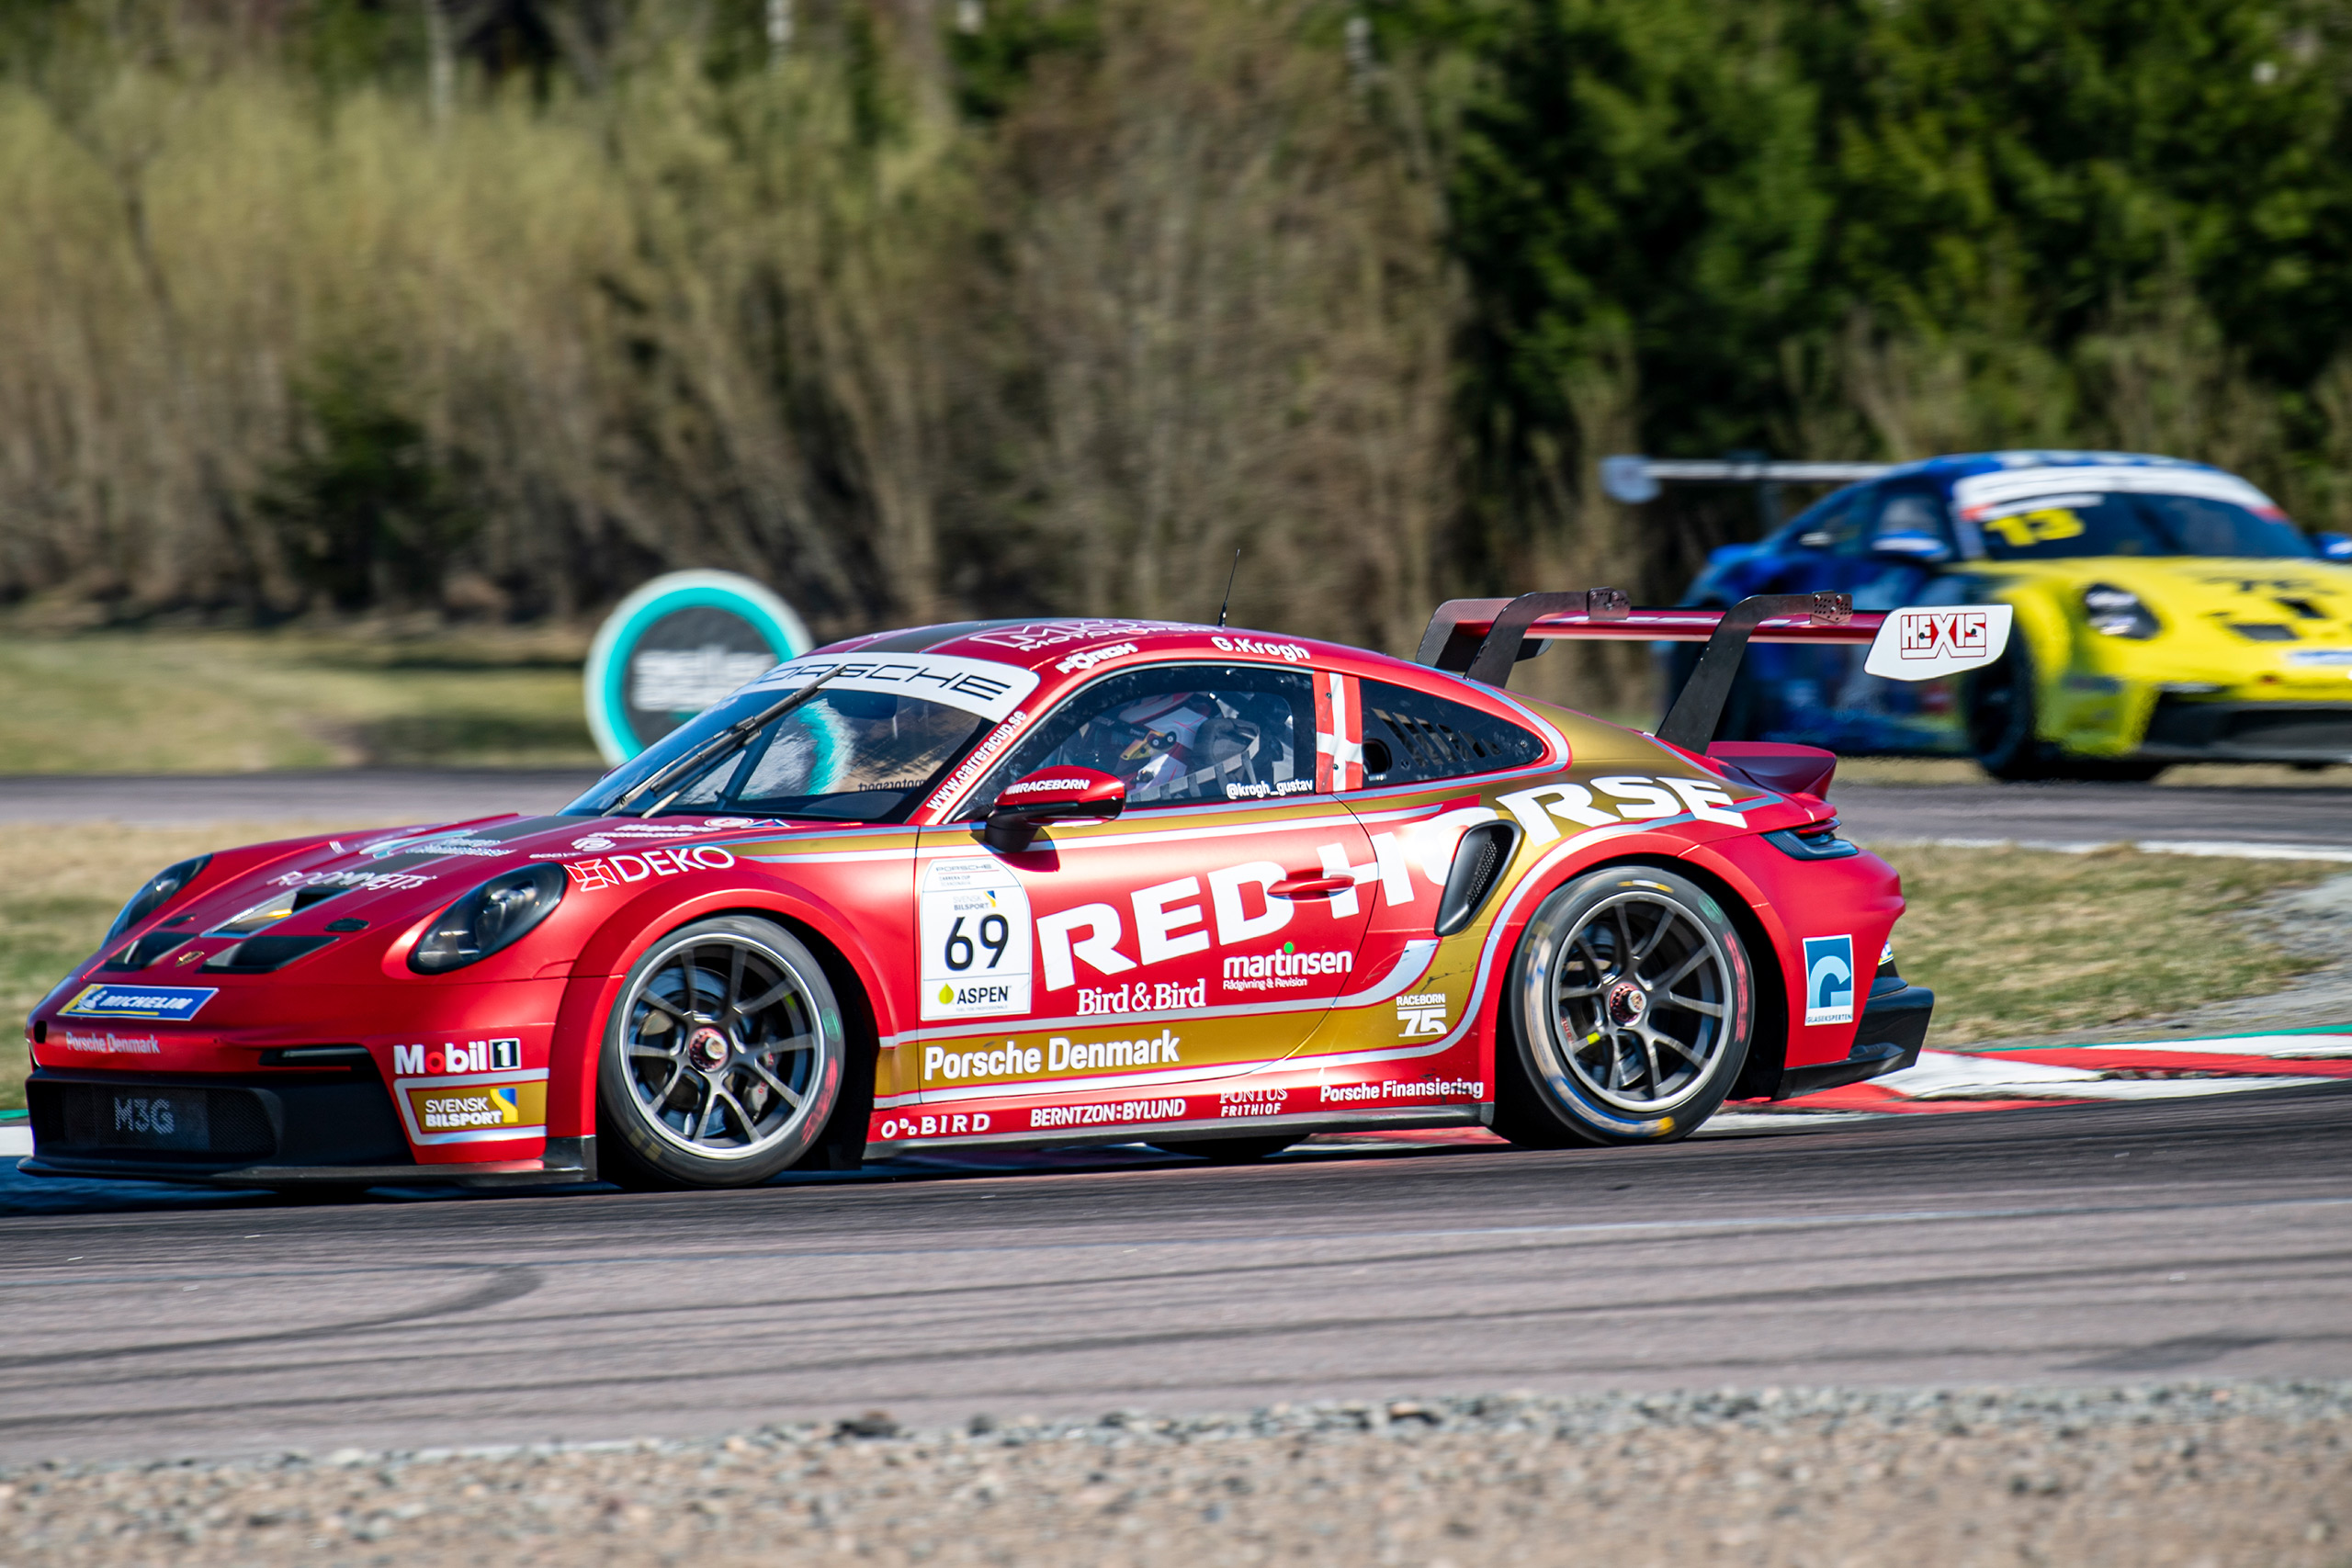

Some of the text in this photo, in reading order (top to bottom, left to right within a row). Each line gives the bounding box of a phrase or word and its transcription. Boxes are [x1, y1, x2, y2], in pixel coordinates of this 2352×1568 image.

[1984, 507, 2086, 546] 13
[1901, 613, 1986, 660] HEXIS
[1211, 637, 1310, 662] G.Krogh
[755, 663, 1012, 701] ORSCHE
[926, 710, 1027, 812] www.carreracup.se
[1020, 779, 1091, 792] RACEBORN
[1226, 779, 1313, 799] @krogh_gustav
[608, 846, 735, 883] DEKO
[935, 863, 992, 872] PORSCHE
[954, 902, 989, 910] BILSPORT
[1035, 861, 1295, 991] RED
[944, 914, 1010, 972] 69
[1224, 942, 1352, 979] martinsen
[1274, 977, 1307, 988] Revision
[99, 995, 193, 1010] MICHELIN
[956, 986, 1009, 1005] ASPEN
[1396, 994, 1446, 1007] RACEBORN
[1396, 1009, 1447, 1037] 75
[1806, 1013, 1852, 1023] GLASEKSPERTEN
[66, 1032, 161, 1054] Porsche Denmark
[393, 1041, 488, 1075] Mobil
[924, 1029, 1181, 1081] Porsche Denmark
[1320, 1077, 1485, 1103] Porsche Finansiering
[425, 1097, 489, 1113] SVENSK
[1221, 1102, 1282, 1118] FRITHIOF
[425, 1111, 503, 1128] BILSPORT
